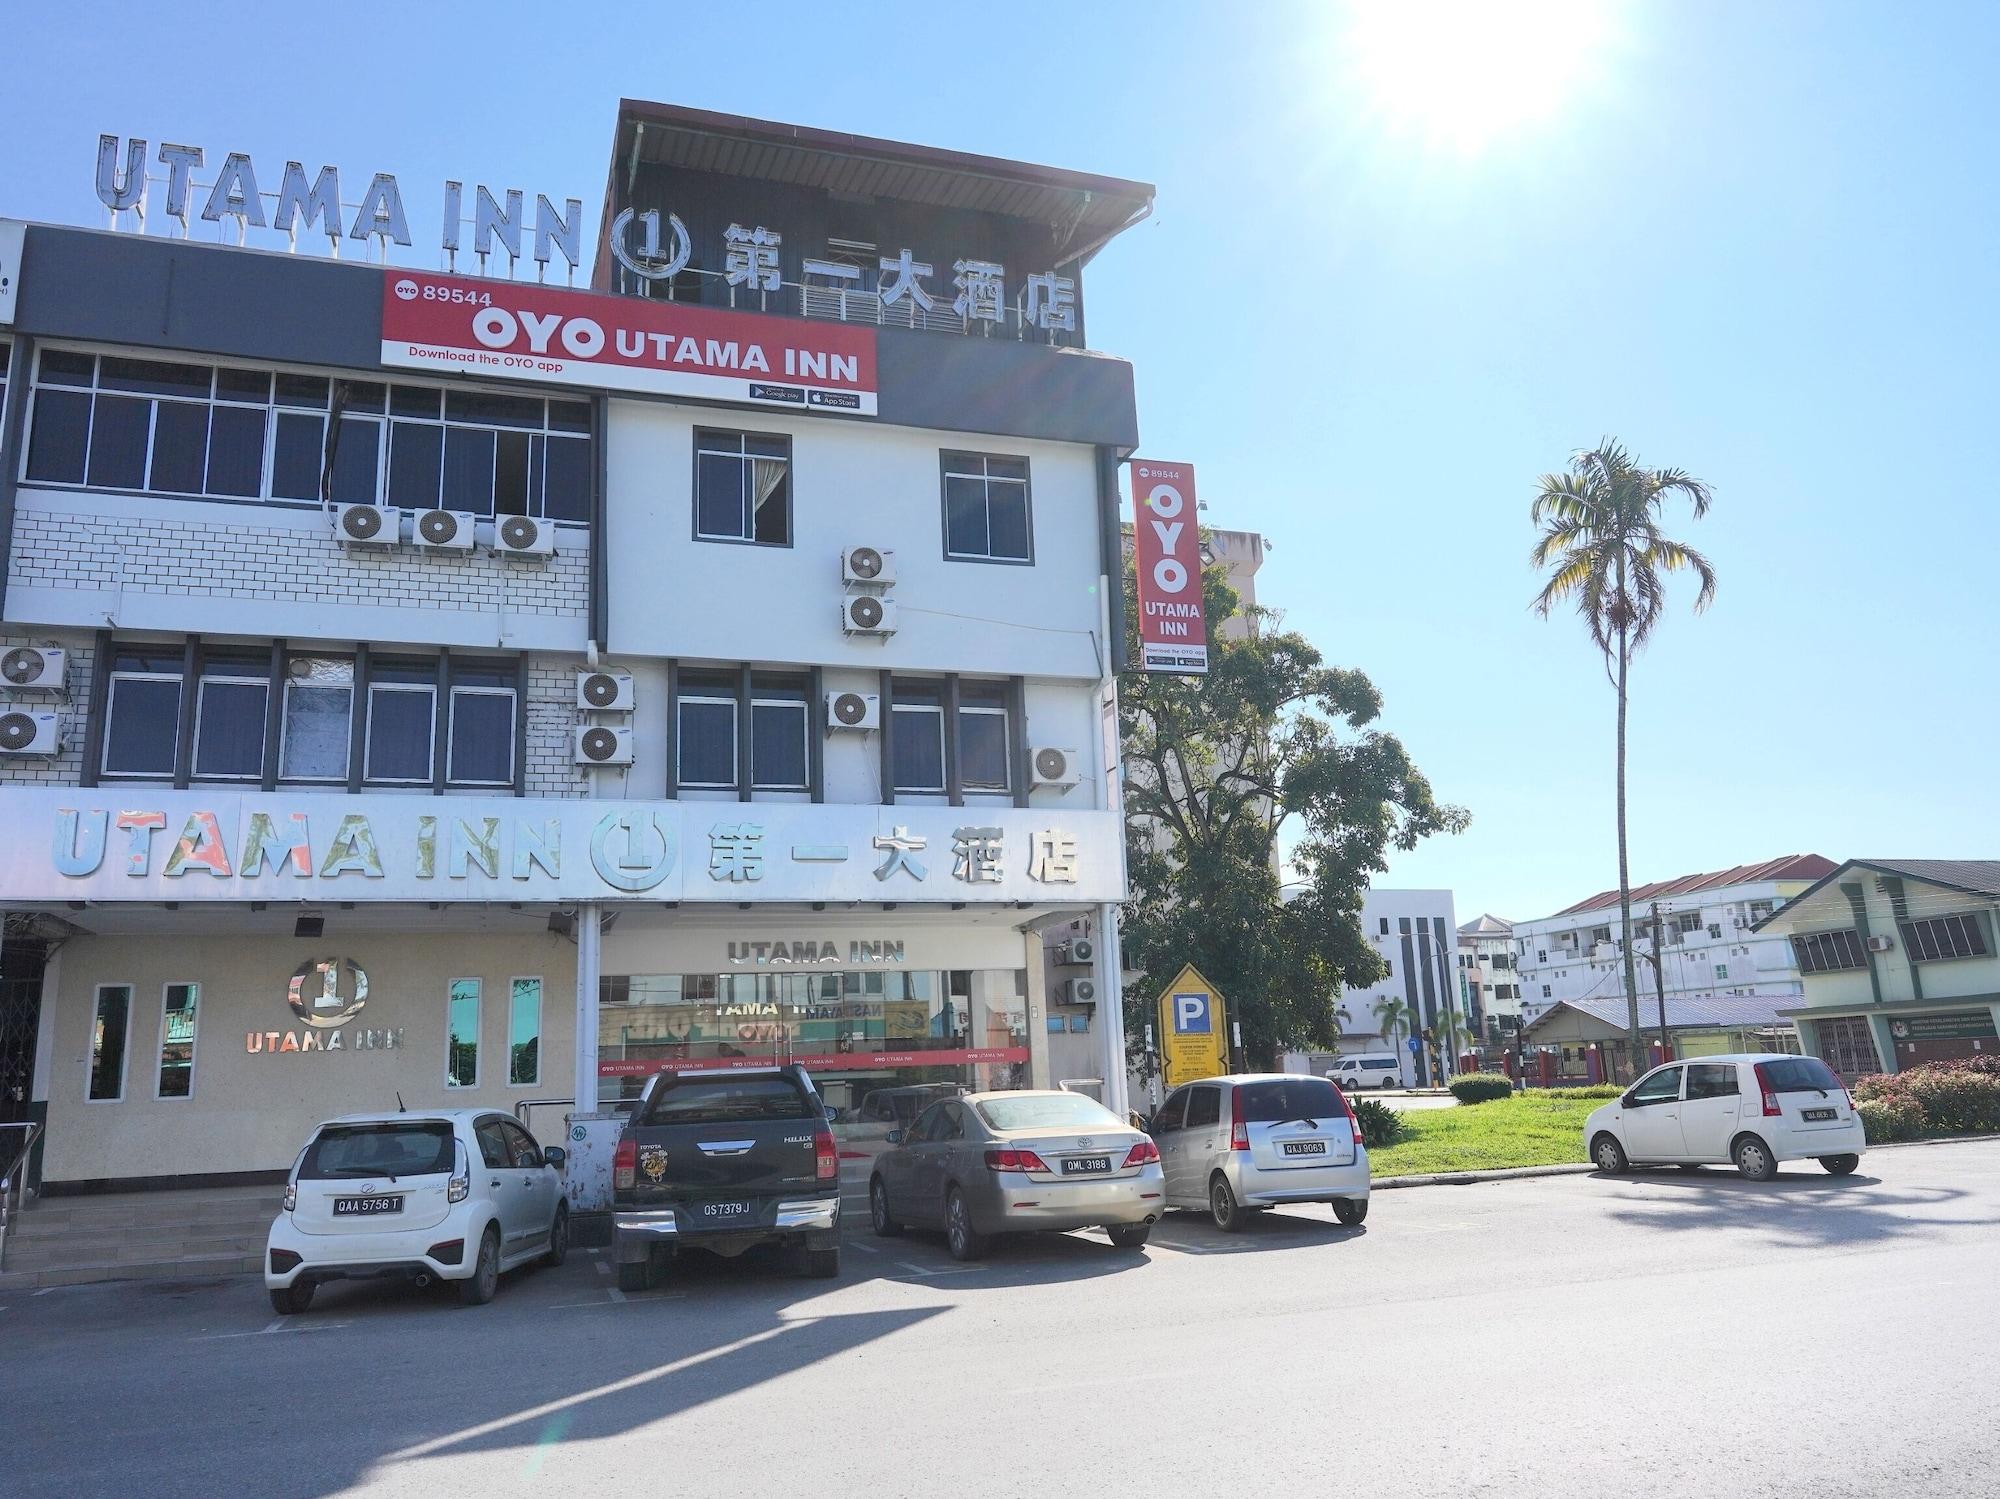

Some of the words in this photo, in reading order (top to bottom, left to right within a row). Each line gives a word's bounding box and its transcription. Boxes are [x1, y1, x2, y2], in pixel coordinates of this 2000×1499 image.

[95, 134, 412, 246] UTAMA
[442, 180, 582, 267] INN
[722, 223, 1076, 332] 第一大酒店
[423, 285, 492, 307] 89544
[472, 307, 606, 359] OYO
[616, 328, 771, 373] UTAMA
[785, 348, 858, 383] INN
[408, 346, 475, 363] Download
[479, 354, 500, 365] the
[504, 356, 534, 369] OYO
[537, 362, 563, 373] app
[1150, 470, 1180, 480] 89544
[1145, 601, 1201, 618] UTAMA
[1159, 621, 1188, 637] INN
[51, 808, 385, 878] UTAMA
[415, 815, 562, 880] INN
[707, 822, 1080, 883] 第一大酒店
[727, 940, 841, 965] UTAMA
[850, 940, 905, 964] INN
[1178, 997, 1205, 1030] P
[246, 1029, 347, 1053] UTAMA
[355, 1027, 405, 1050] INN
[783, 1135, 813, 1143] HILUX
[1303, 1143, 1324, 1153] 9063
[1086, 1159, 1107, 1170] 3188
[338, 1201, 359, 1212] QAA
[362, 1199, 389, 1211] 5756
[392, 1198, 399, 1209] T
[718, 1203, 743, 1215] 7379
[744, 1202, 750, 1213] J
